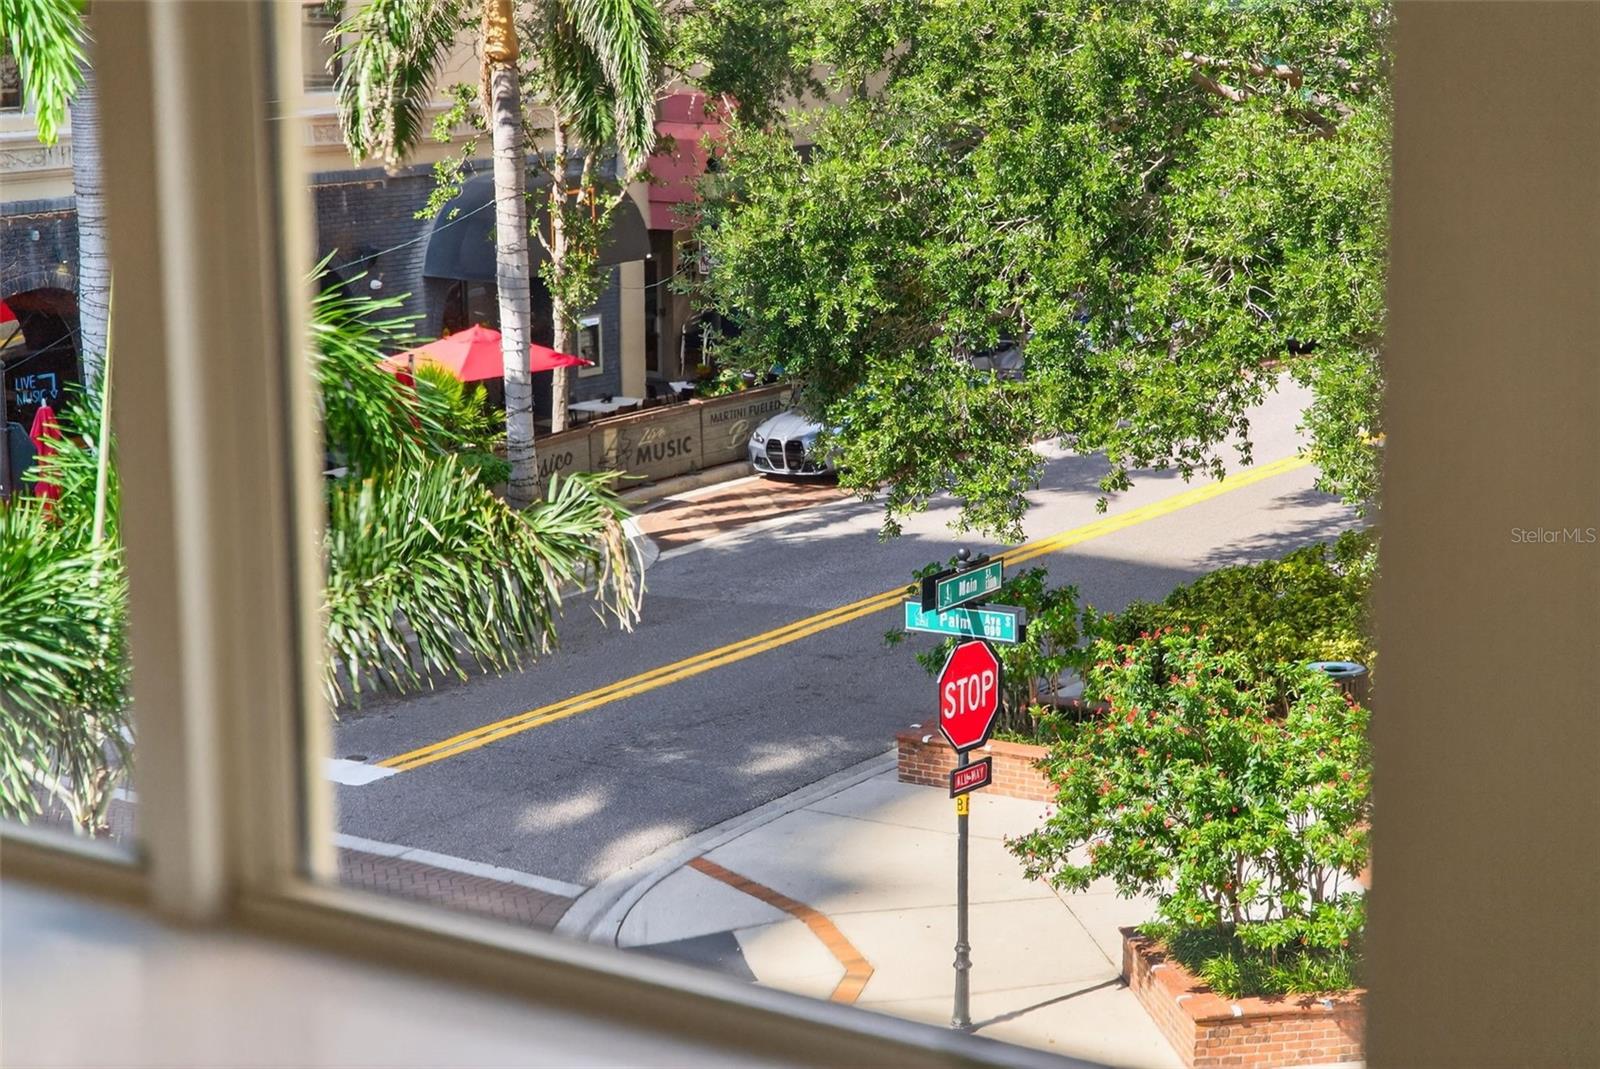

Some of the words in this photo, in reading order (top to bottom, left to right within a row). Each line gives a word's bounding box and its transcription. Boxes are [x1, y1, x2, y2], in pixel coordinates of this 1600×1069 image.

[15, 375, 36, 391] LIVE
[710, 407, 746, 424] MARTINI
[748, 399, 781, 417] FUELED
[635, 435, 692, 466] MUSIC
[958, 577, 977, 597] Main
[939, 611, 972, 630] Palm
[1004, 615, 1012, 628] S
[943, 669, 995, 720] STOP
